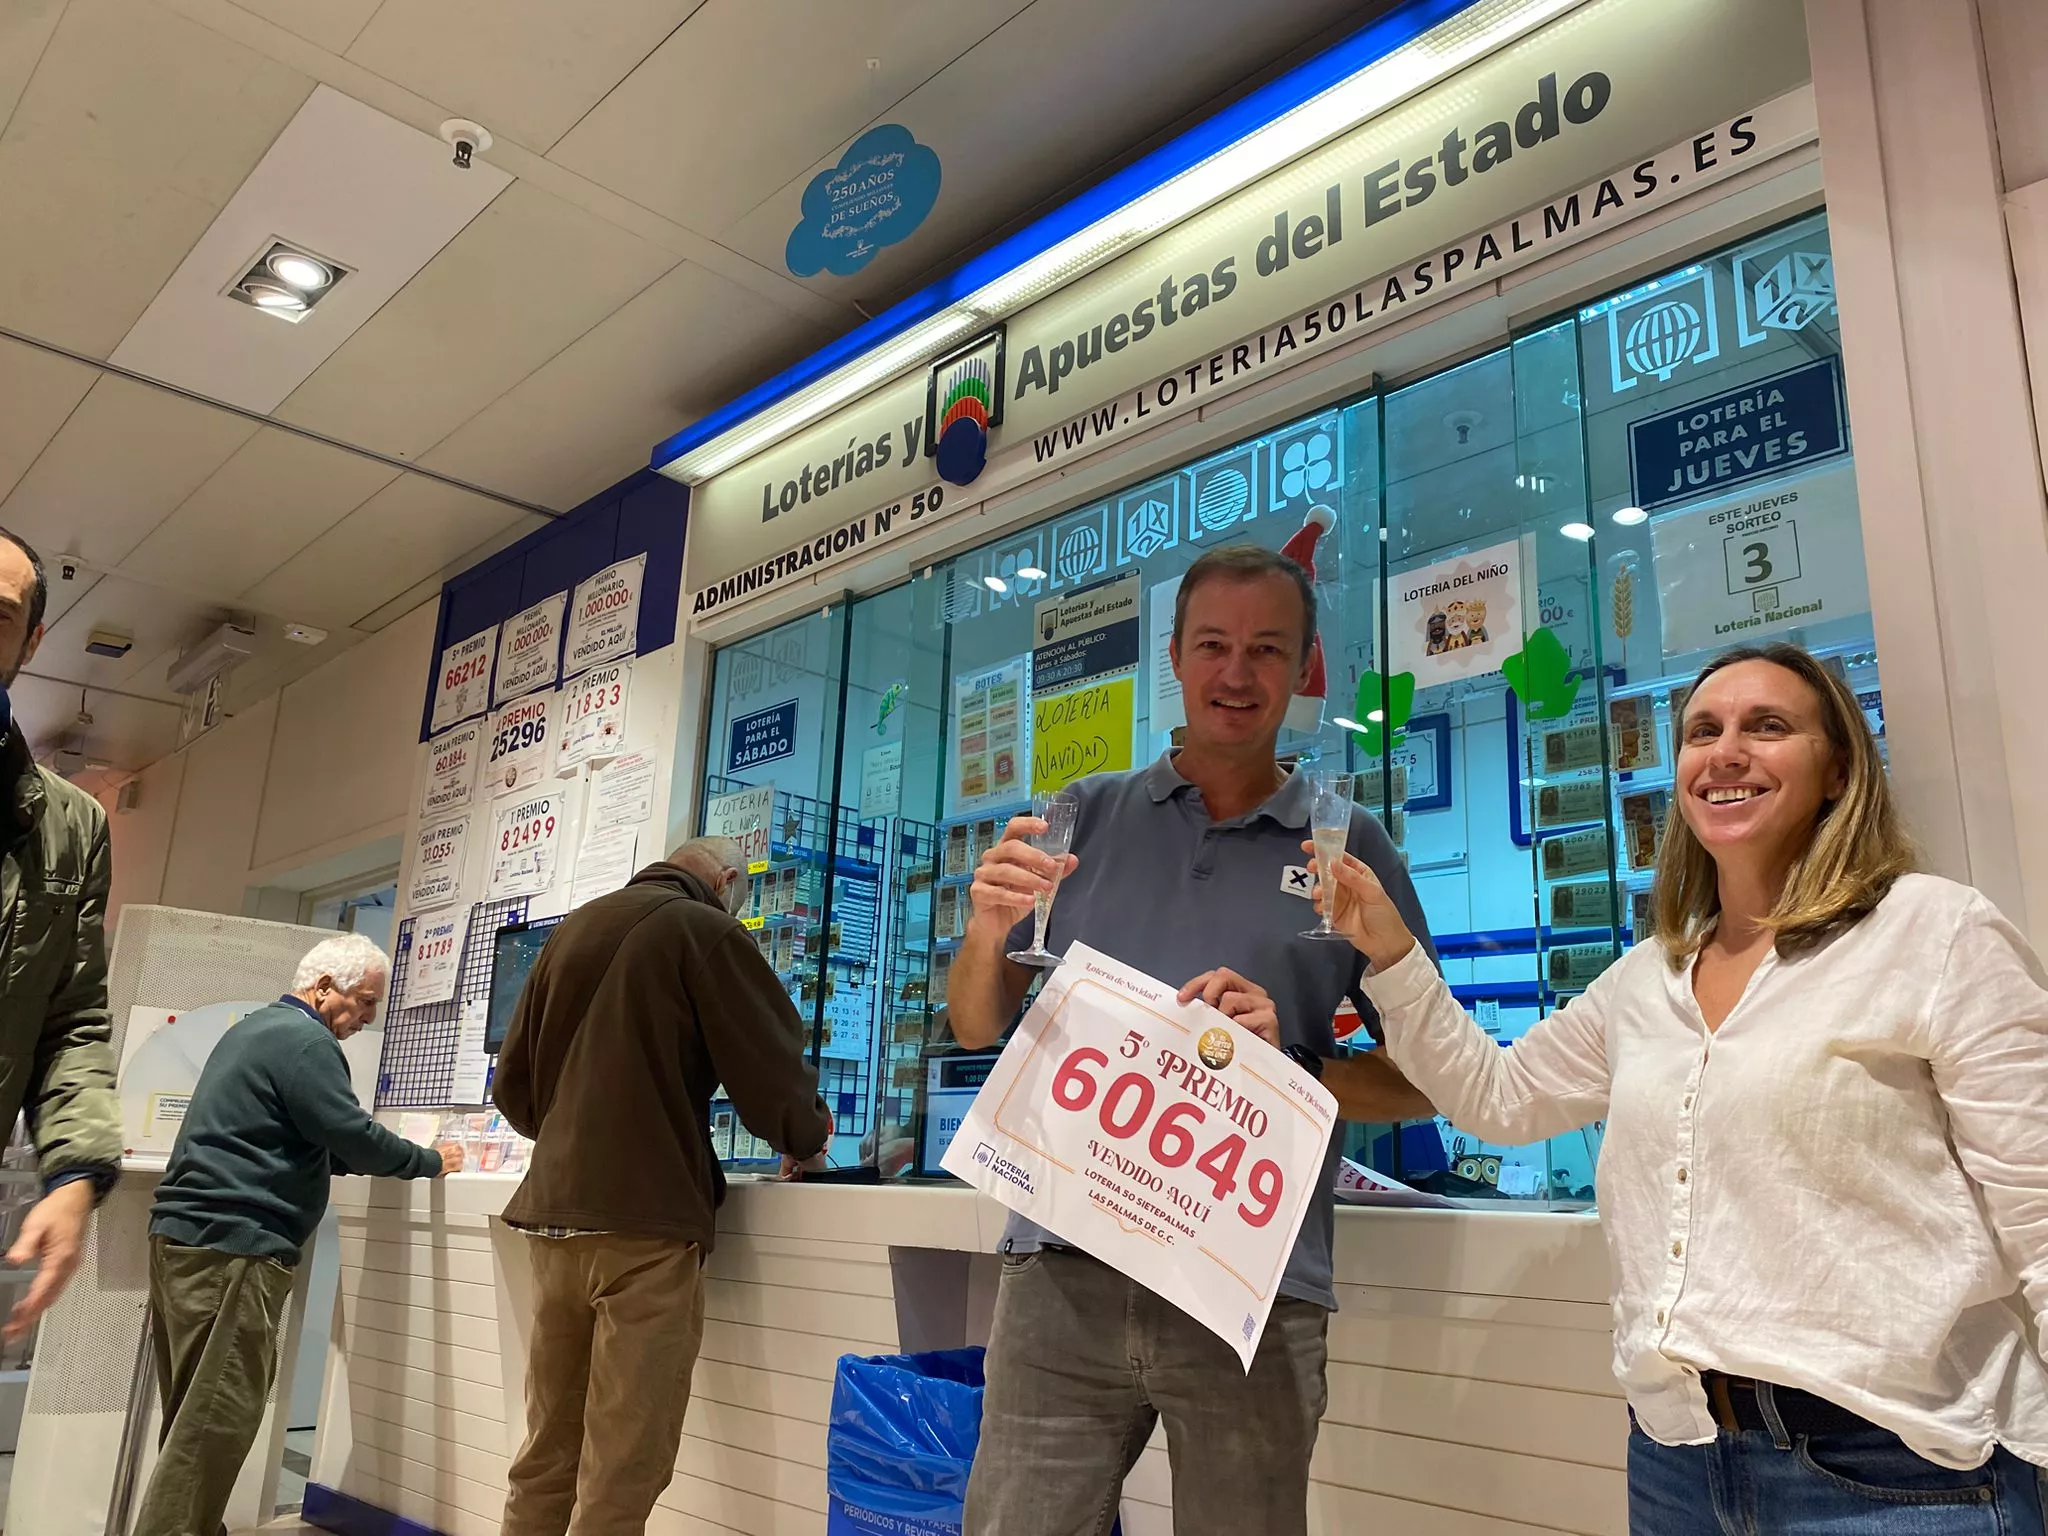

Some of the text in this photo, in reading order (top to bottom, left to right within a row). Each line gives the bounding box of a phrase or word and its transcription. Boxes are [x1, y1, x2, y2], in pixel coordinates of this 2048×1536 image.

[831, 168, 895, 203] 250 AÑOS
[831, 191, 895, 224] DE SUEÑOS
[762, 71, 1612, 523] Loterías y Apuestas del Estado
[1033, 115, 1757, 463] WWW.LOTERIA50LASPALMAS.ES
[1678, 389, 1785, 436] LOTERÍA
[1680, 411, 1787, 458] PARA EL
[1667, 430, 1808, 493] JUEVES
[1708, 491, 1799, 526] ESTE JUEVES
[1726, 510, 1782, 535] SORTEO
[692, 518, 866, 615] ADMINISTRACION
[911, 486, 944, 520] 50
[1742, 542, 1773, 585] 3
[587, 579, 625, 601] MILLONARIO
[595, 569, 617, 587] PREMIO
[1403, 563, 1509, 602] LOTERIA DEL NIÑO
[516, 614, 548, 635] MILLONARIO
[523, 607, 543, 623] PREMIO
[1060, 597, 1133, 628] Apuestas del Estado
[1765, 599, 1823, 624] Nacional
[460, 636, 486, 657] PREMIO
[573, 639, 606, 660] VENDIDO
[607, 626, 627, 648] AQUÍ
[1067, 643, 1077, 651] AL
[445, 654, 487, 690] 66212
[502, 659, 548, 690] VENDIDO AQUÍ
[1035, 660, 1055, 672] Lunes
[1063, 662, 1083, 677] 20:30
[581, 667, 619, 694] PREMIO
[975, 673, 1003, 690] BOTES
[502, 701, 546, 731] PREMIO
[565, 683, 621, 725] 11833
[745, 711, 781, 733] LOTERÍA
[433, 730, 476, 756] GRAN PREMIO
[489, 716, 547, 763] 25296
[745, 727, 780, 745] PARA EL
[735, 738, 788, 765] SÁBADO
[426, 784, 468, 807] VENDIDO AQUÍ
[516, 799, 550, 823] PREMIO
[420, 824, 464, 847] GRAN PREMIO
[500, 816, 556, 852] 82499
[722, 820, 735, 835] EL
[412, 883, 436, 901] VENDIDO
[432, 923, 454, 938] PREMIO
[417, 938, 453, 961] 81789
[1114, 976, 1125, 986] de
[851, 1032, 859, 1040] 28
[1119, 1029, 1150, 1059] 5º
[1156, 1048, 1268, 1138] PREMIO
[1288, 1078, 1298, 1090] 22
[1051, 1047, 1284, 1228] 60649
[991, 1165, 1035, 1195] NACIONAL
[994, 1155, 1031, 1183] LOTERÍA
[1088, 1139, 1213, 1223] VENDIDO AQUÍ
[1084, 1168, 1196, 1239] LOTERIA 50 SIETEPALMAS
[1088, 1189, 1175, 1246] LAS PALMAS DE G.C.
[896, 1519, 903, 1533] Y
